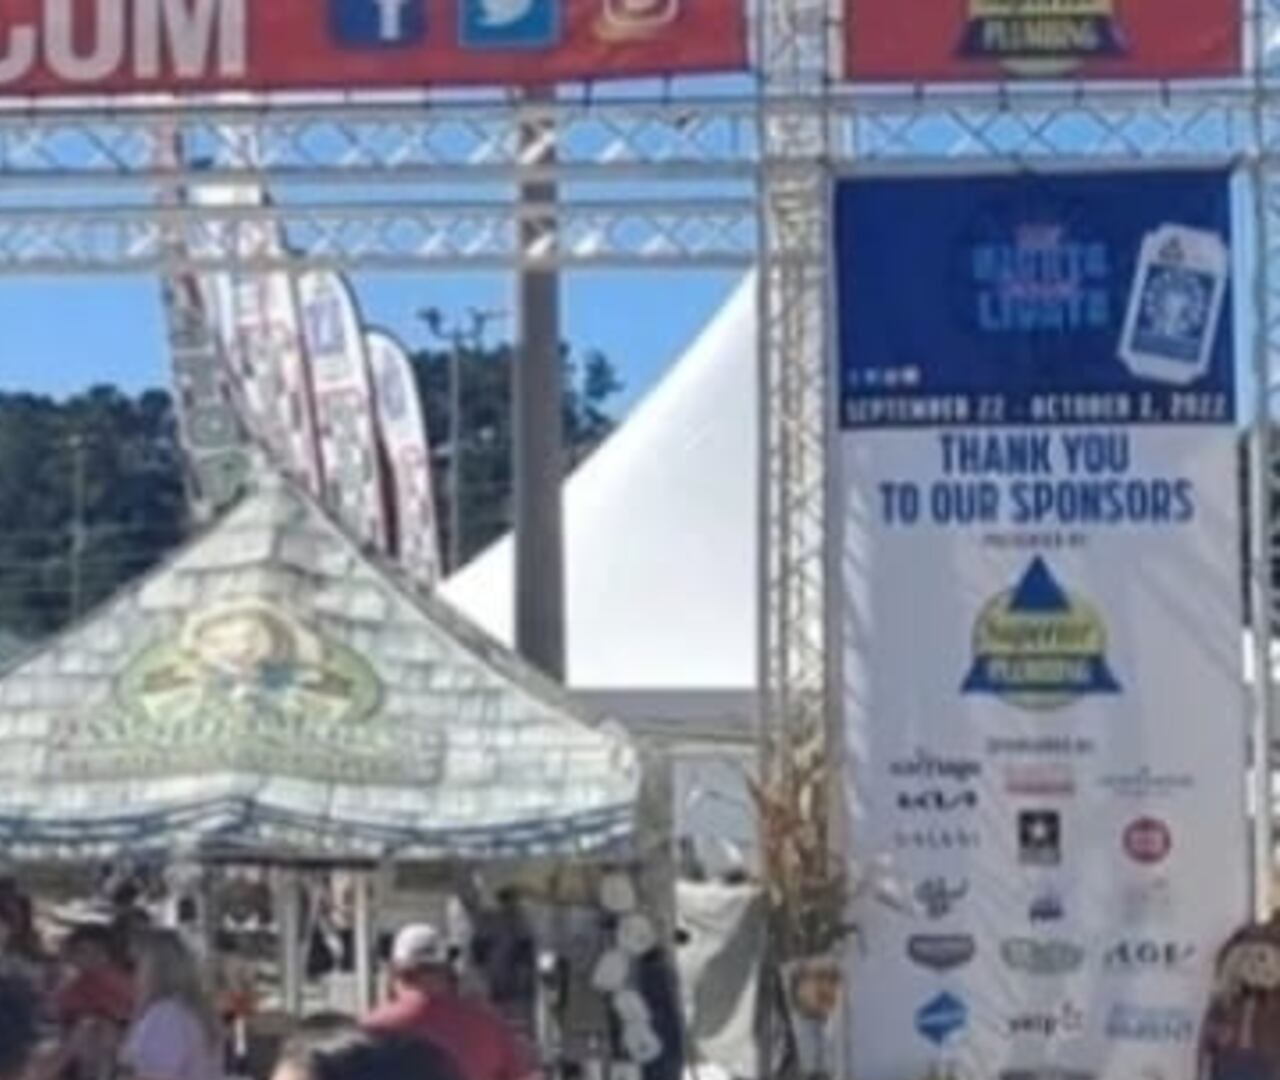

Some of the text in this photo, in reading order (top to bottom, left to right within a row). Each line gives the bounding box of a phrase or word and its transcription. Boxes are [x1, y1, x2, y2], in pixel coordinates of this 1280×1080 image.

[845, 395, 969, 422] SEPTEMBER
[977, 395, 1005, 420] 22
[1032, 394, 1131, 420] OCTOBER
[1169, 392, 1227, 418] 2022
[939, 433, 1130, 475] THANK YOU
[879, 478, 1195, 525] TO OUR SPONSORS
